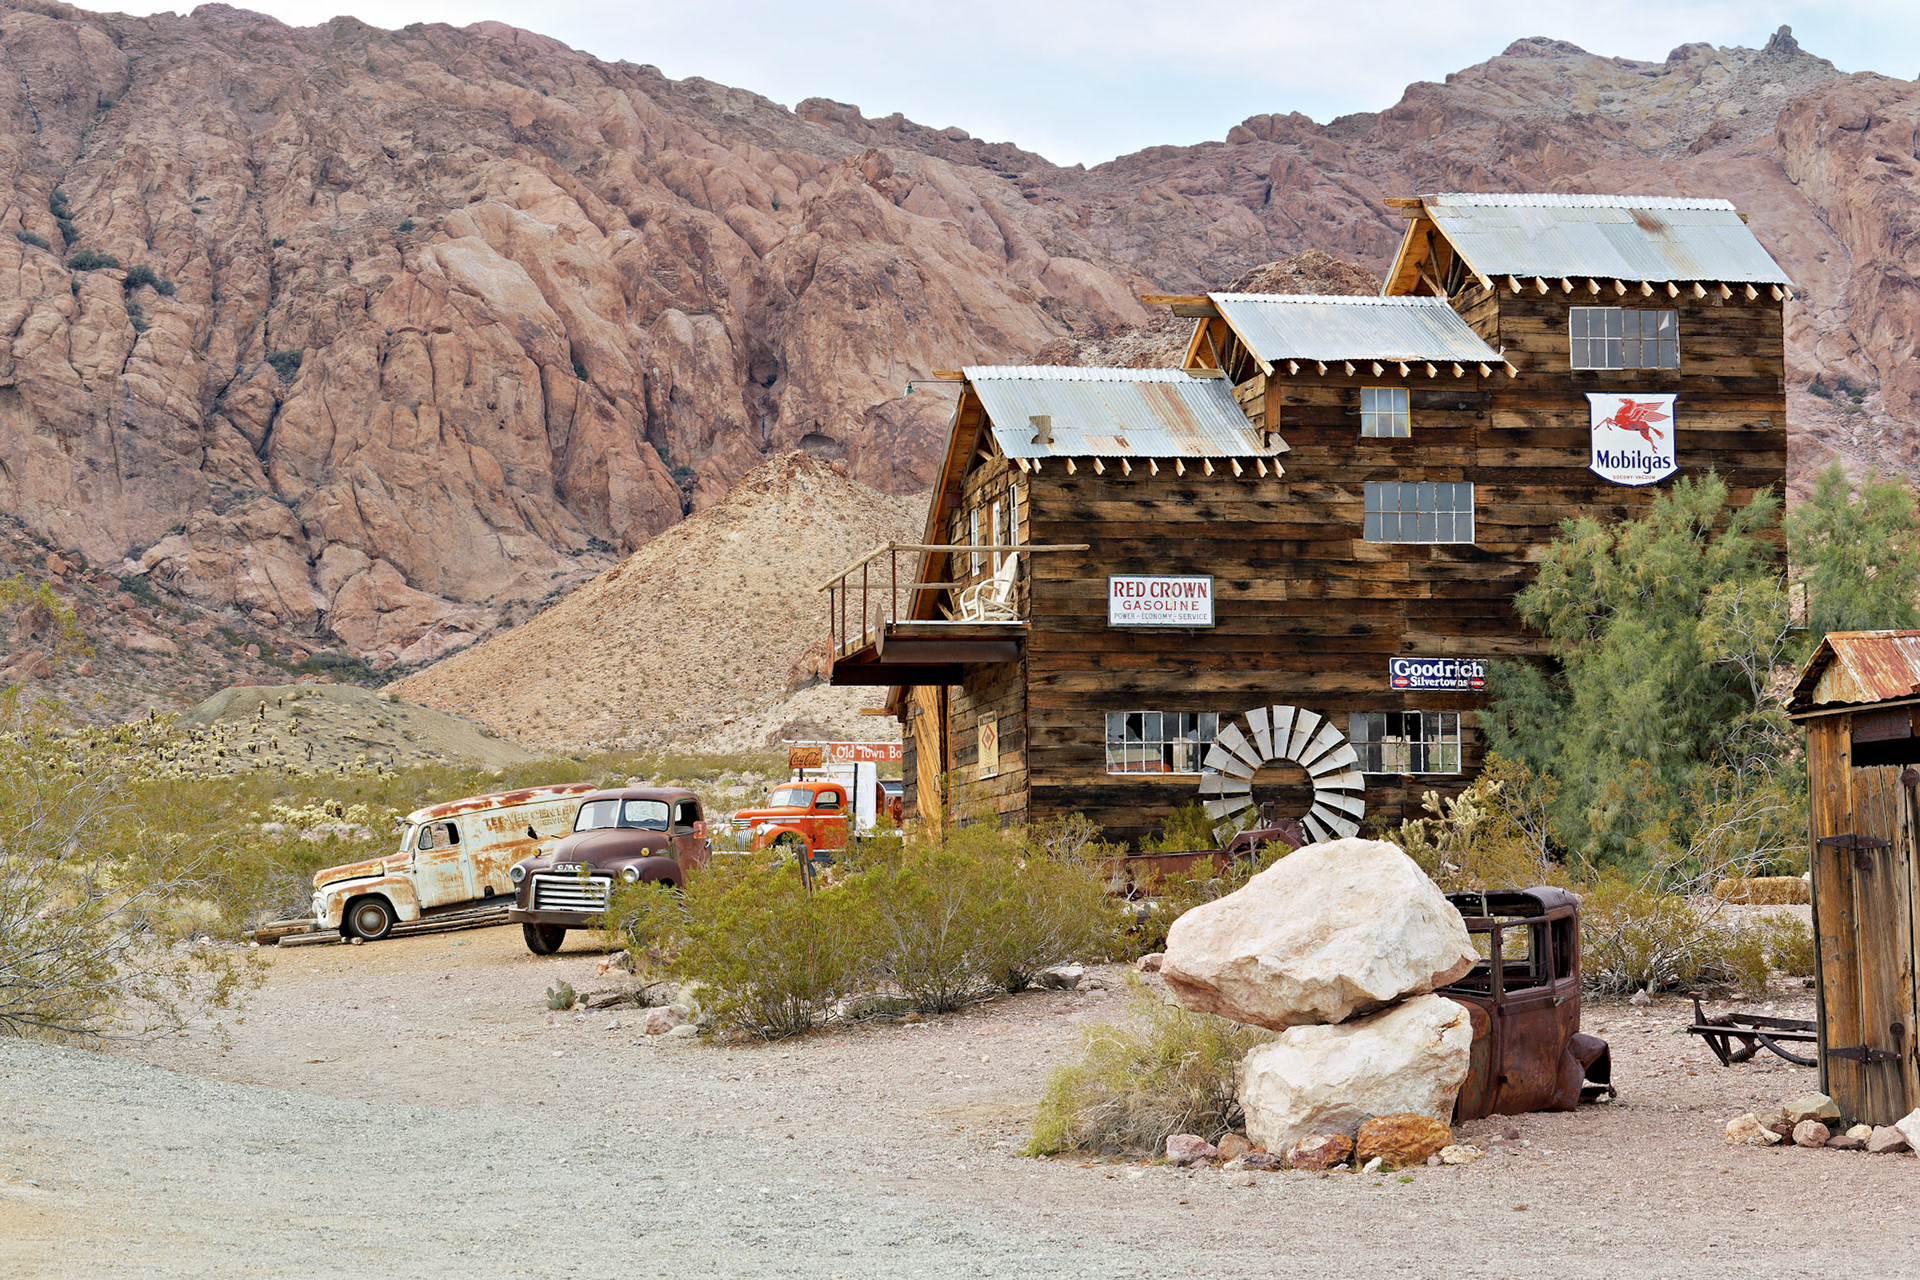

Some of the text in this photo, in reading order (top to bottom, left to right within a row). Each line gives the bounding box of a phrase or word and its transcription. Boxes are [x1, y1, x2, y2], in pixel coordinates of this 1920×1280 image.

[1597, 450, 1671, 474] Mobilgas
[1114, 581, 1207, 598] RED CROWN
[1122, 600, 1200, 611] GASOLINE
[1113, 612, 1136, 620] POWER
[1141, 612, 1172, 620] ECONOMY
[1177, 613, 1208, 621] SERVICE
[1394, 660, 1484, 677] Goodrich
[1410, 677, 1468, 686] Silvertowns
[836, 745, 855, 759] Old
[856, 744, 885, 759] Town
